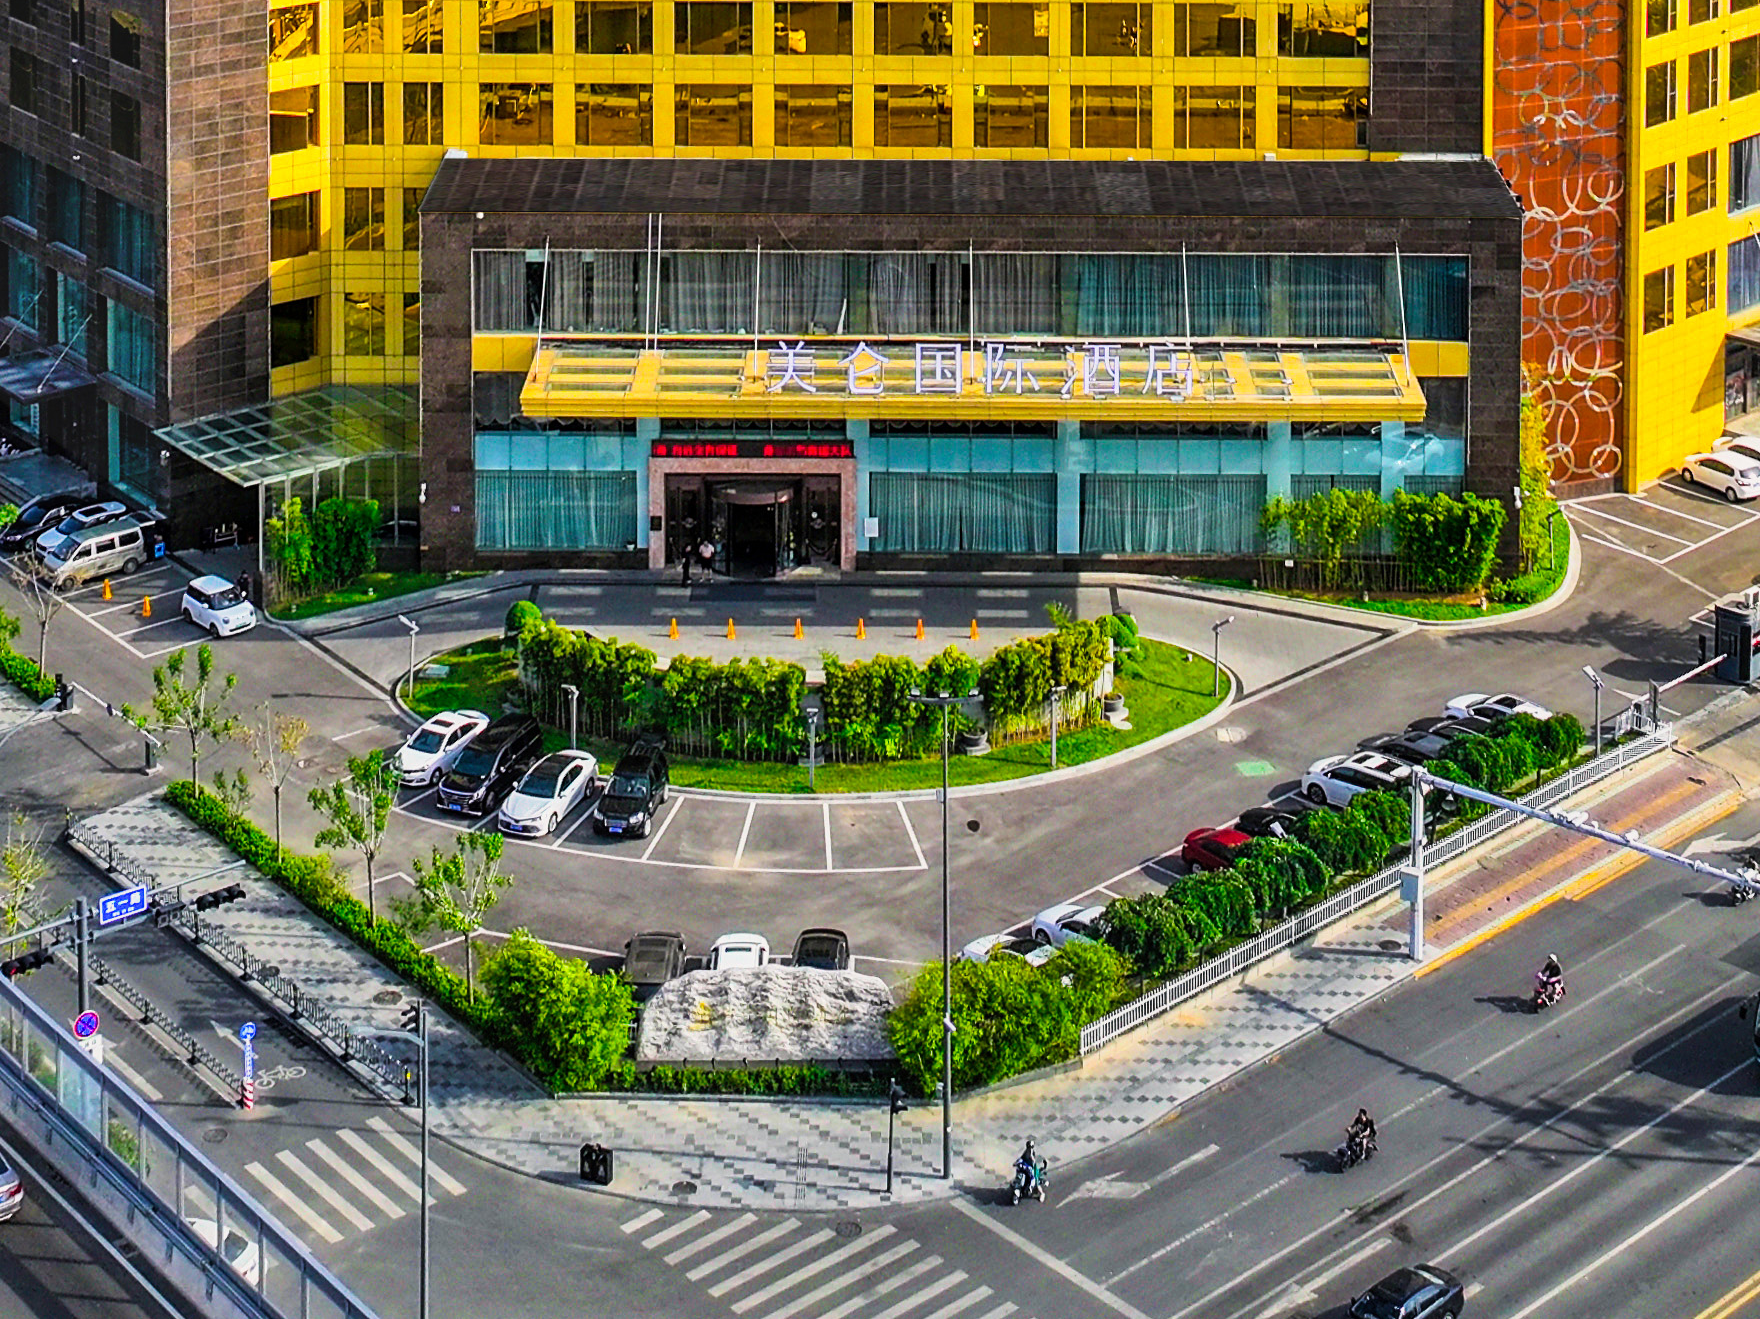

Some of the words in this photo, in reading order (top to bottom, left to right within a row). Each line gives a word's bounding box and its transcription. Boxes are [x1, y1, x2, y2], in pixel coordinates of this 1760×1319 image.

[766, 340, 1193, 395] 美仑国际酒店
[105, 891, 142, 913] 五一路
